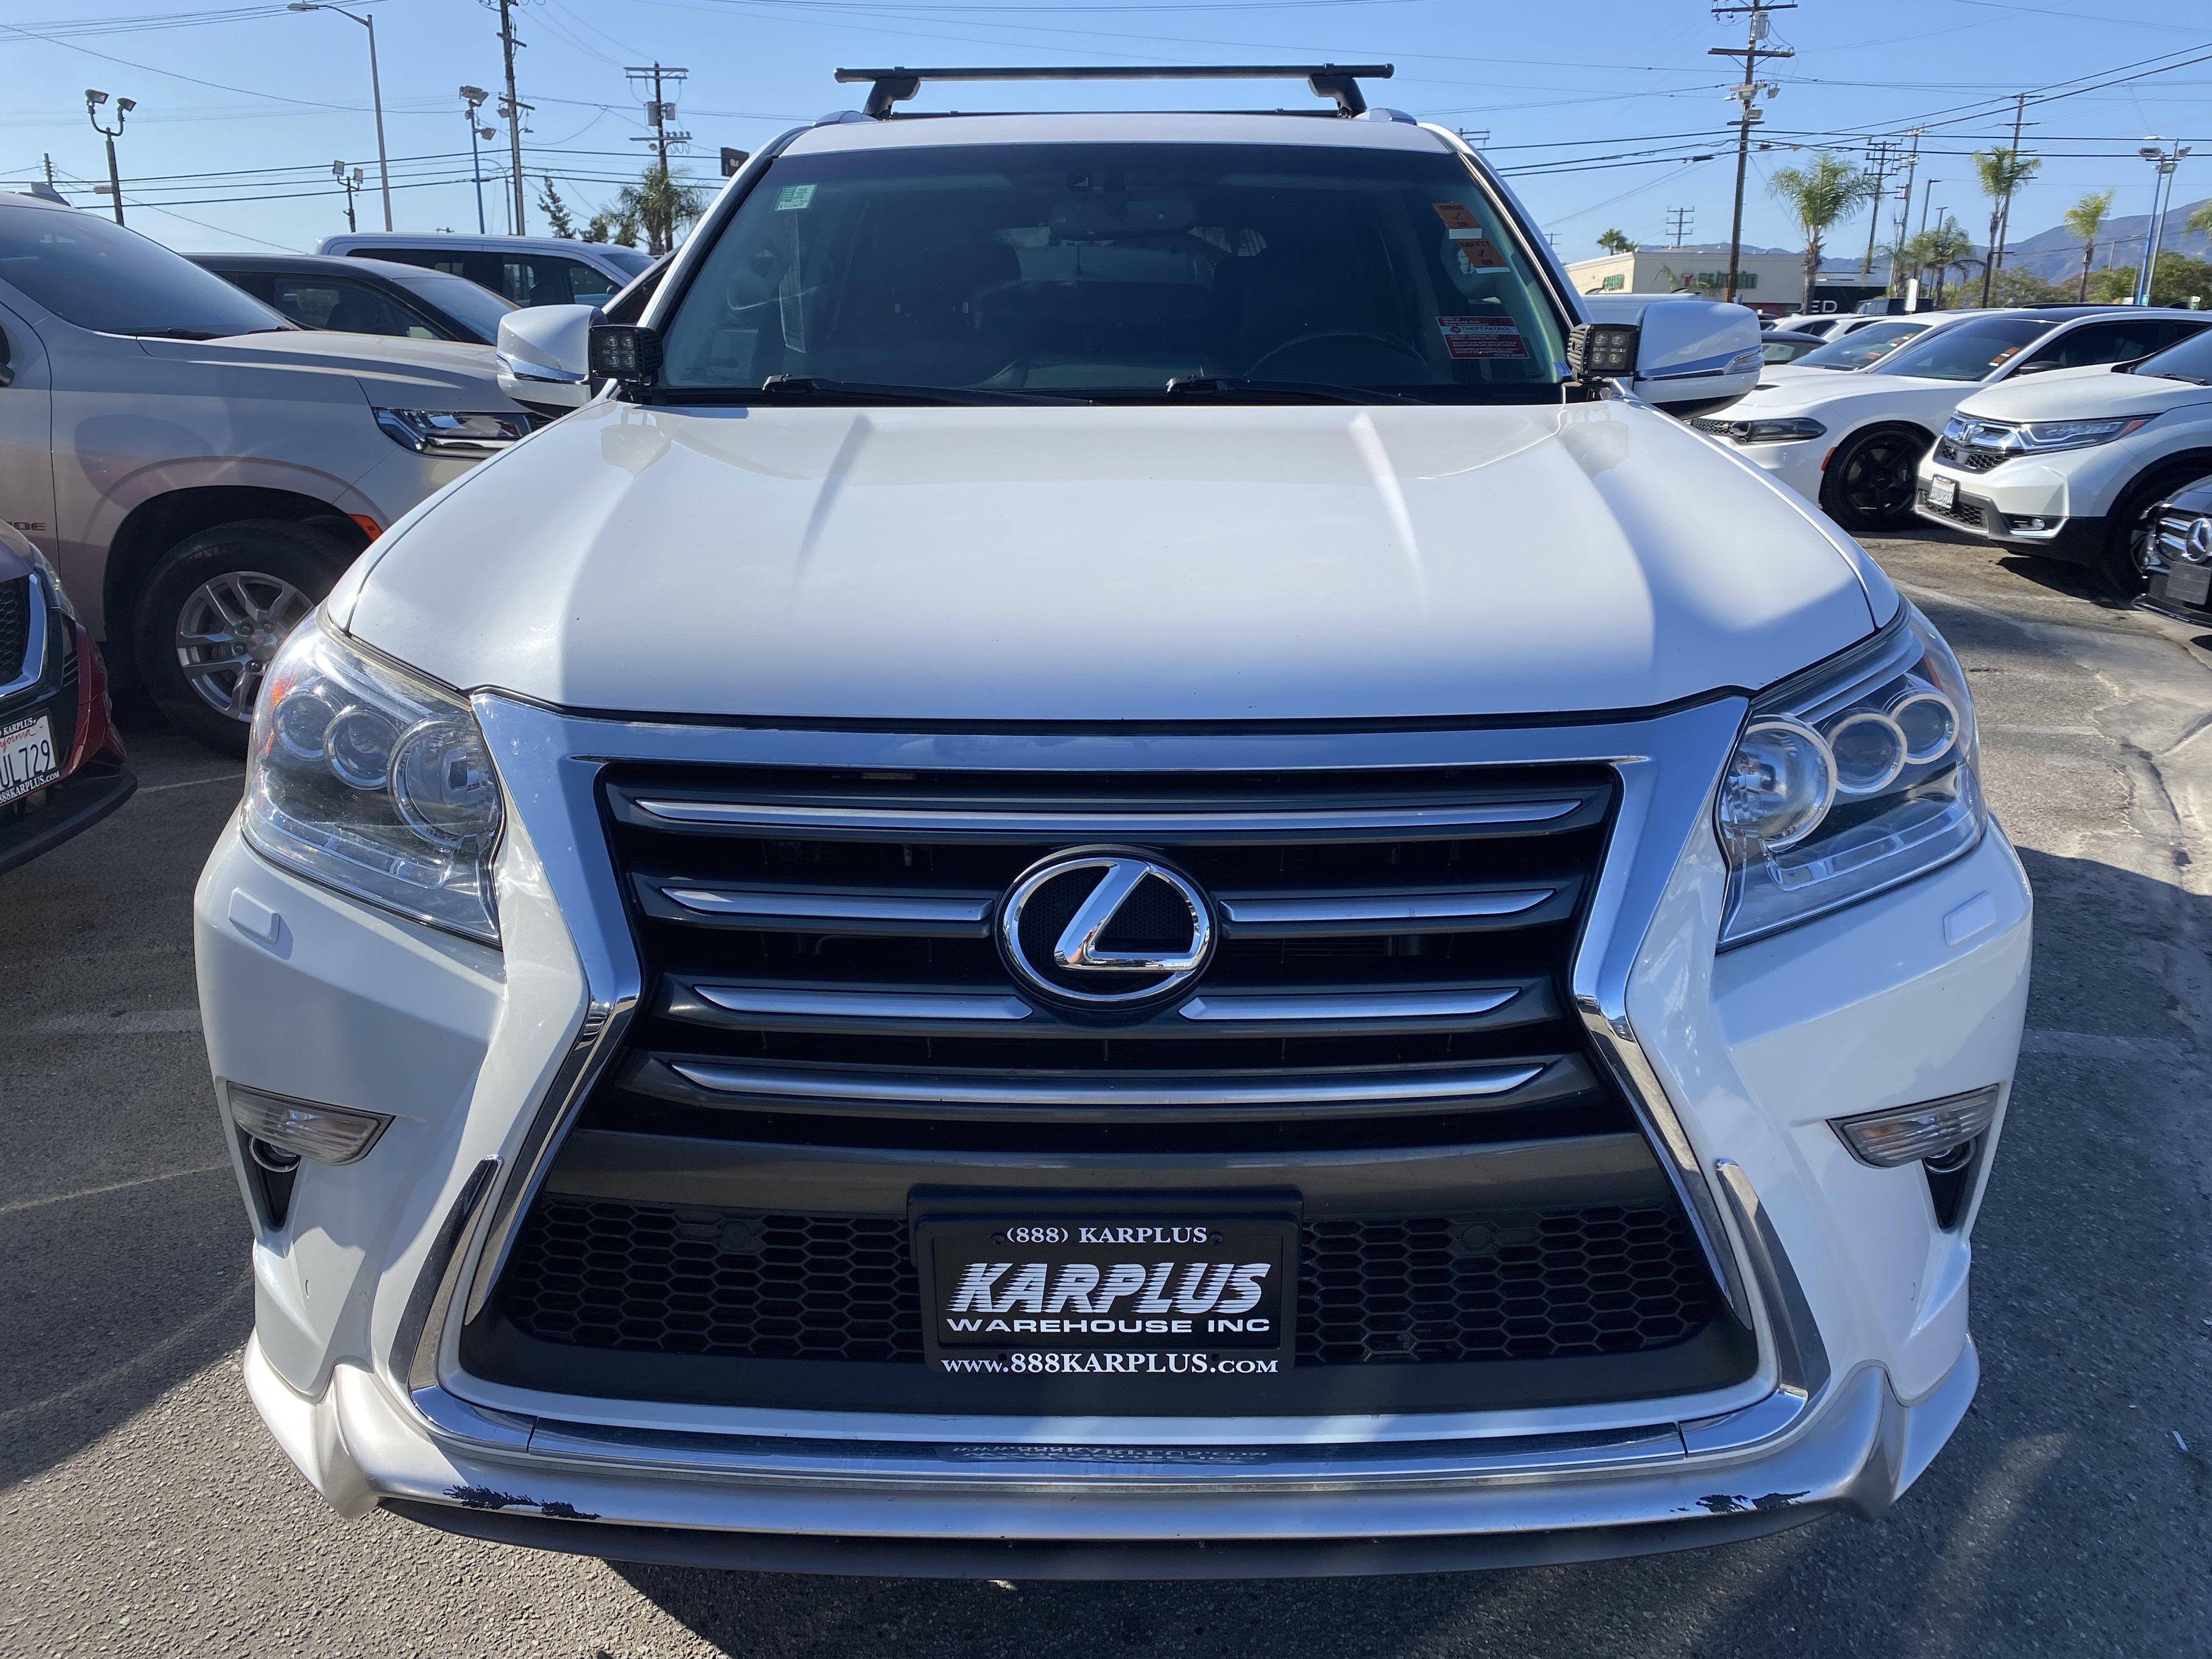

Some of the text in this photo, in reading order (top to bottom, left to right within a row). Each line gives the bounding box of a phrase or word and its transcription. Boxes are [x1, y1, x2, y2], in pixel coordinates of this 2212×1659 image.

[3, 717, 33, 736] KARPLUS
[1007, 1227, 1207, 1244] (888) KARPLUS
[945, 1262, 1272, 1314] KARPLUS
[946, 1318, 1270, 1333] WAREHOUSE INC
